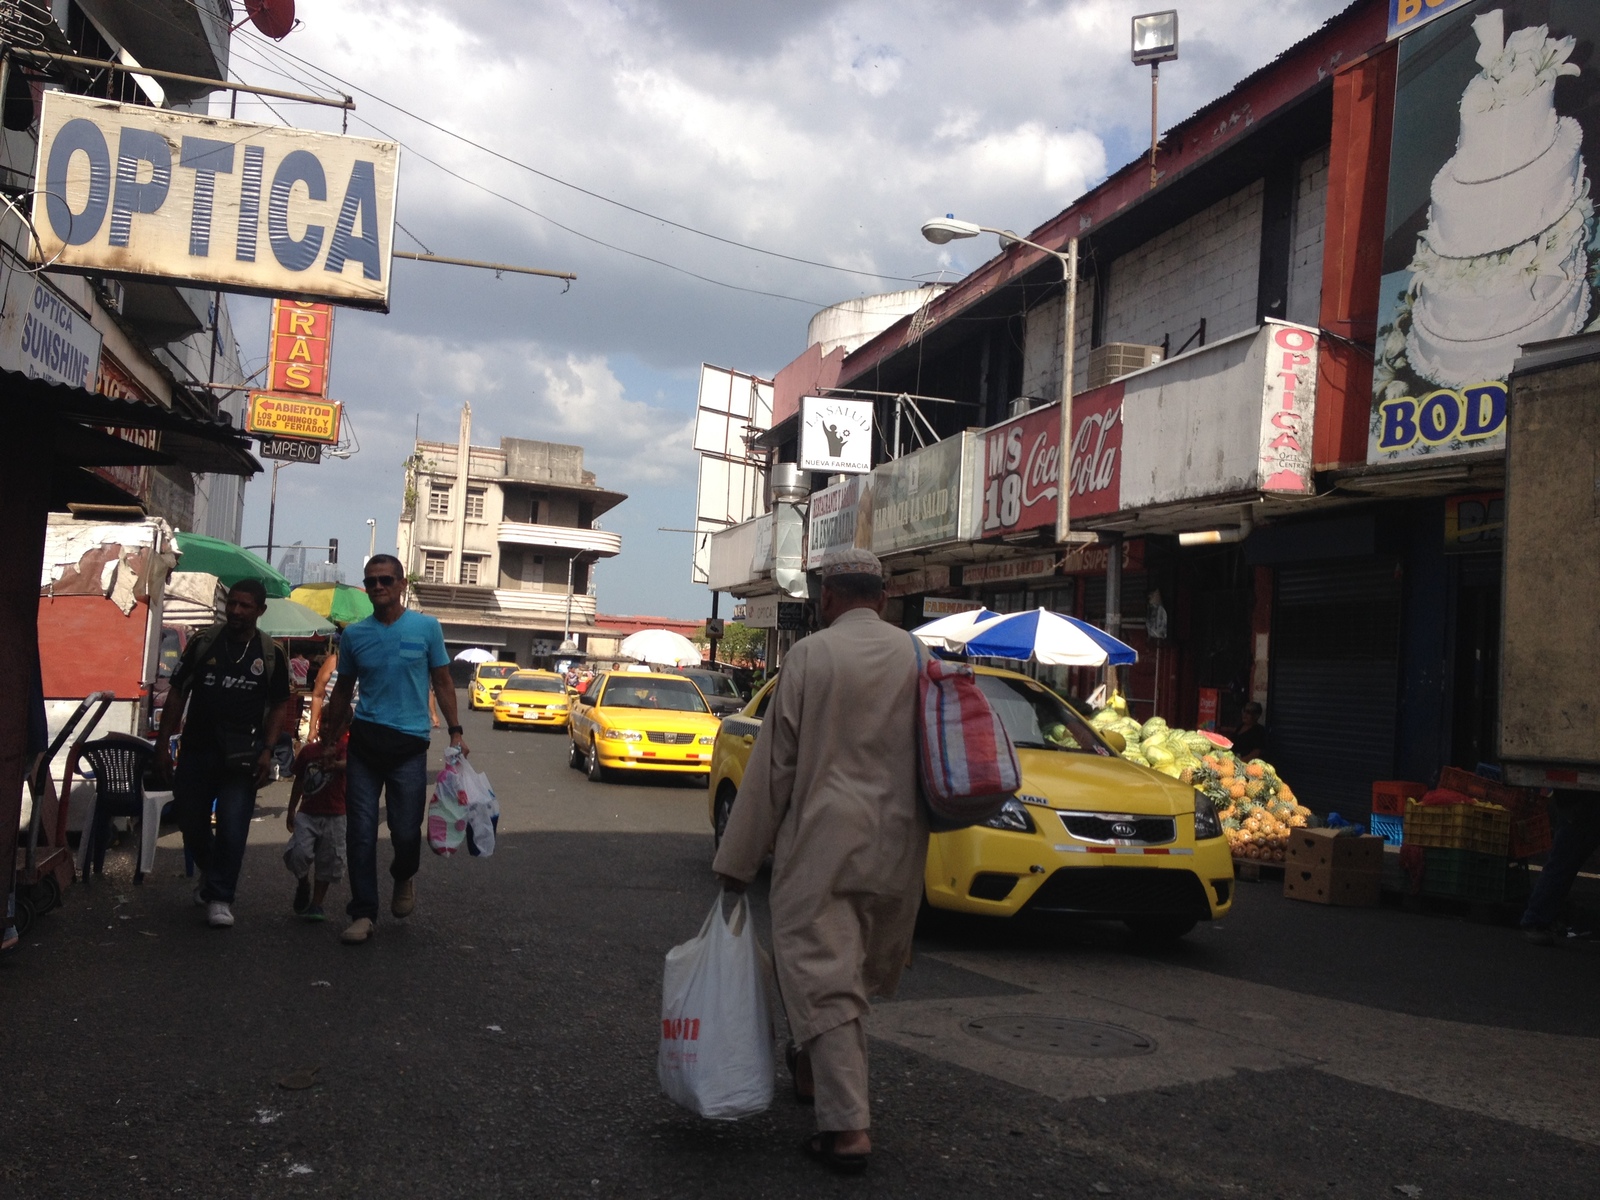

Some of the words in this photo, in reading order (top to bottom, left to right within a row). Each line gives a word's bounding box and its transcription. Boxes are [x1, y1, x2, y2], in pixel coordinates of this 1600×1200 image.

[46, 118, 381, 282] OPTICA
[34, 285, 73, 334] OPTICA
[21, 312, 90, 388] SUNSHINE
[1267, 328, 1315, 452] OPTICA
[257, 412, 272, 420] LOS
[276, 414, 318, 425] DOMINGOS
[322, 419, 329, 427] Y
[275, 403, 321, 416] ABIERTO
[826, 405, 871, 432] SALUD
[256, 419, 277, 428] DIAS
[284, 422, 329, 434] FERIADOS
[263, 441, 317, 460] EMPEÑO
[805, 459, 830, 467] NUEVA
[831, 461, 869, 469] FARMACIA
[874, 501, 908, 531] FARMACIA
[911, 499, 920, 522] LA
[922, 488, 949, 520] SALUD
[984, 473, 1022, 530] 18
[1021, 795, 1048, 804] TAXI
[1114, 825, 1132, 834] KIA
